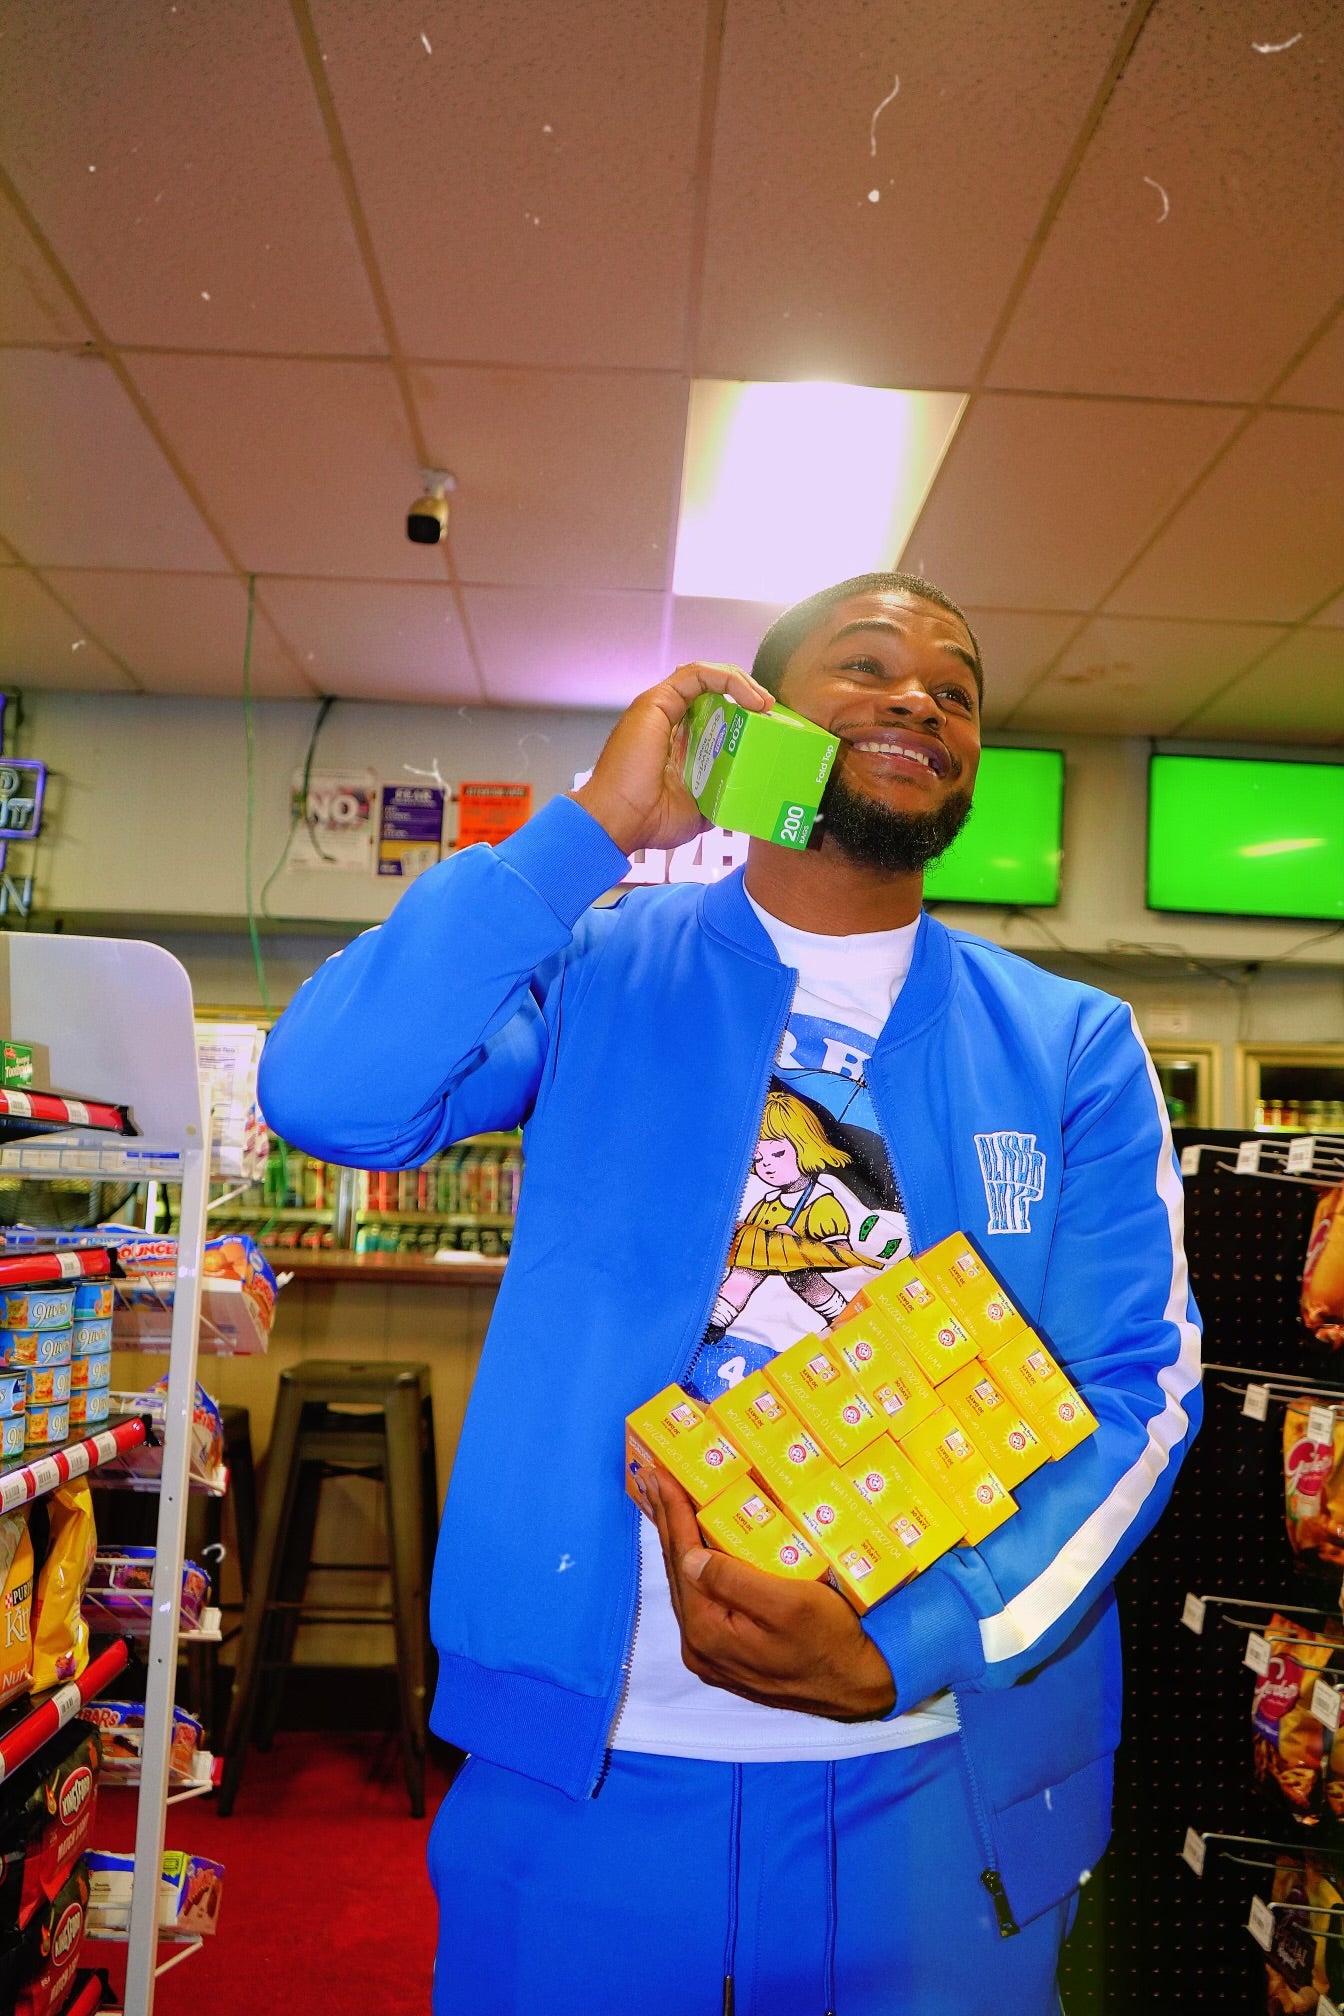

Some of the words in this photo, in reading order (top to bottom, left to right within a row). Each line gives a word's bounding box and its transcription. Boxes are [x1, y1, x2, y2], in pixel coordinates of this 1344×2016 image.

[728, 715, 744, 752] 200
[694, 714, 720, 790] Sandwich
[816, 763, 827, 783] Fold
[823, 745, 833, 760] Top
[781, 806, 804, 842] 200
[800, 825, 809, 844] BAGS
[950, 1265, 961, 1278] DAYS
[898, 1291, 910, 1305] DAYS
[876, 1292, 905, 1324] 2027/04
[907, 1303, 914, 1312] 30
[901, 1321, 918, 1339] EXP
[801, 1368, 813, 1382] DAYS
[1020, 1364, 1032, 1378] DAYS
[781, 1370, 809, 1402] 2027/04
[810, 1380, 818, 1388] 30
[1029, 1376, 1036, 1384] 30
[894, 1379, 900, 1387] 30
[898, 1385, 910, 1400] DAYS
[967, 1393, 979, 1407] DAYS
[746, 1406, 759, 1420] DAYS
[806, 1399, 823, 1418] EXP
[662, 1417, 675, 1430] DAYS
[725, 1407, 755, 1439] 2027/04
[756, 1418, 764, 1427] 30
[750, 1437, 767, 1455] EXP
[937, 1444, 949, 1459] DAYS
[946, 1457, 954, 1465] 30
[734, 1511, 748, 1526] DAYS
[909, 1509, 917, 1517] 30
[914, 1515, 928, 1530] DAYS
[745, 1523, 753, 1531] 30
[856, 1510, 874, 1529] EXP
[870, 1527, 903, 1560] 2027/04
[860, 1542, 869, 1550] 30
[865, 1548, 879, 1563] DAYS
